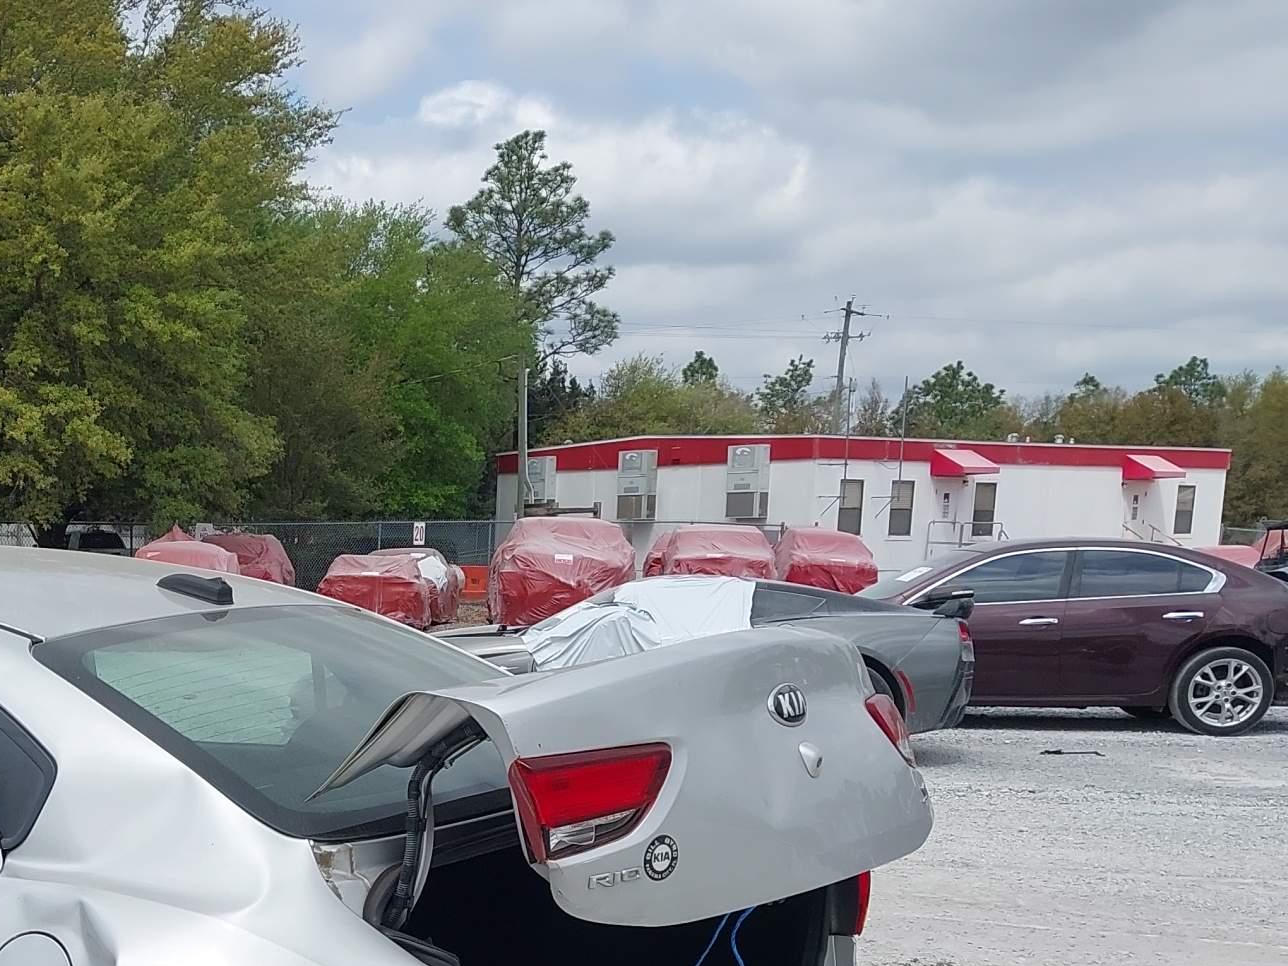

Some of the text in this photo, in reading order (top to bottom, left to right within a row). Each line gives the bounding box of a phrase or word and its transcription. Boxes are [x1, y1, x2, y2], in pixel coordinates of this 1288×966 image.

[414, 526, 425, 542] 20
[777, 690, 807, 719] KIA
[653, 851, 670, 863] KIA
